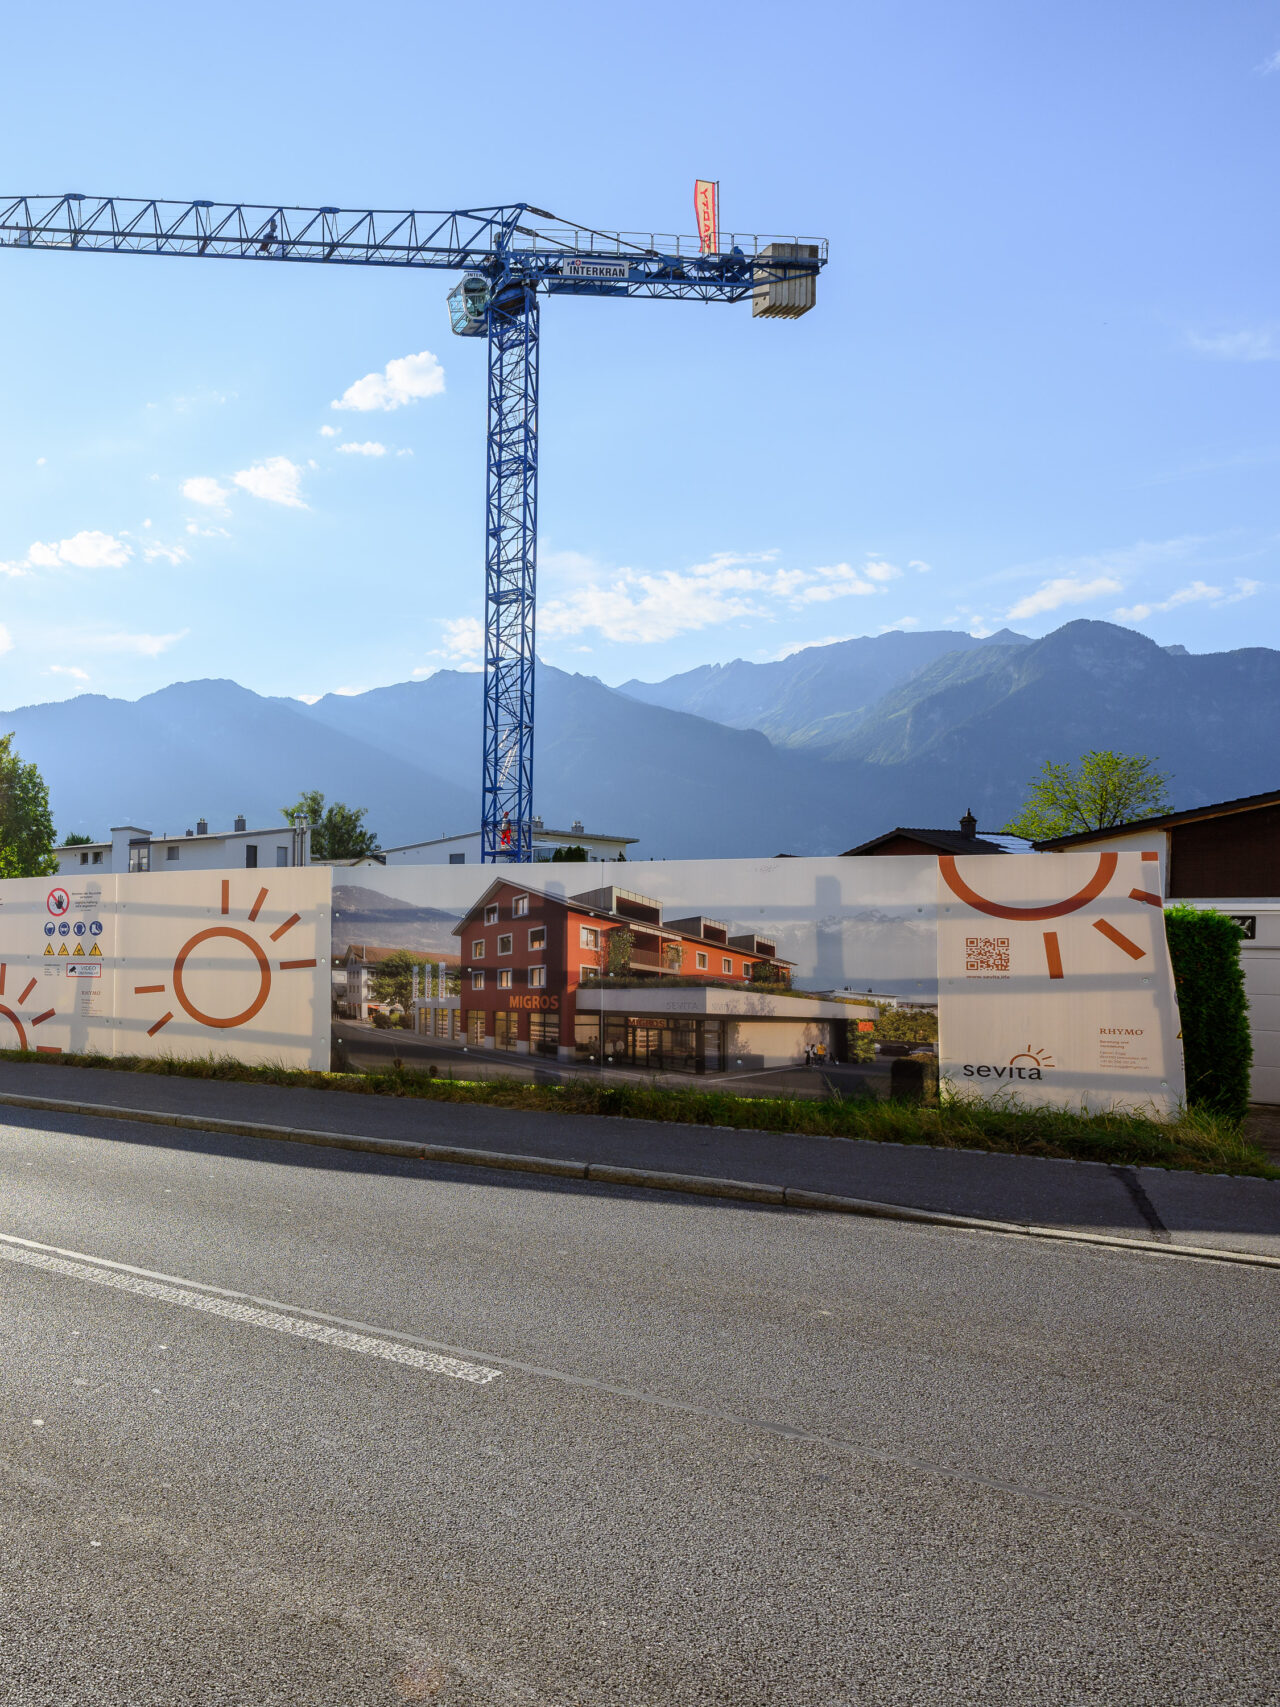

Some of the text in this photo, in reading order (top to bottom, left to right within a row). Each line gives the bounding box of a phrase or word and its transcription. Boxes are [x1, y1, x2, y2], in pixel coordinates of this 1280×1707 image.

[570, 266, 625, 277] INTERKRAN
[509, 995, 559, 1010] MIGROS
[627, 1018, 665, 1028] MIGROS
[1099, 1027, 1144, 1036] RHYMO
[962, 1064, 1043, 1081] sevita
